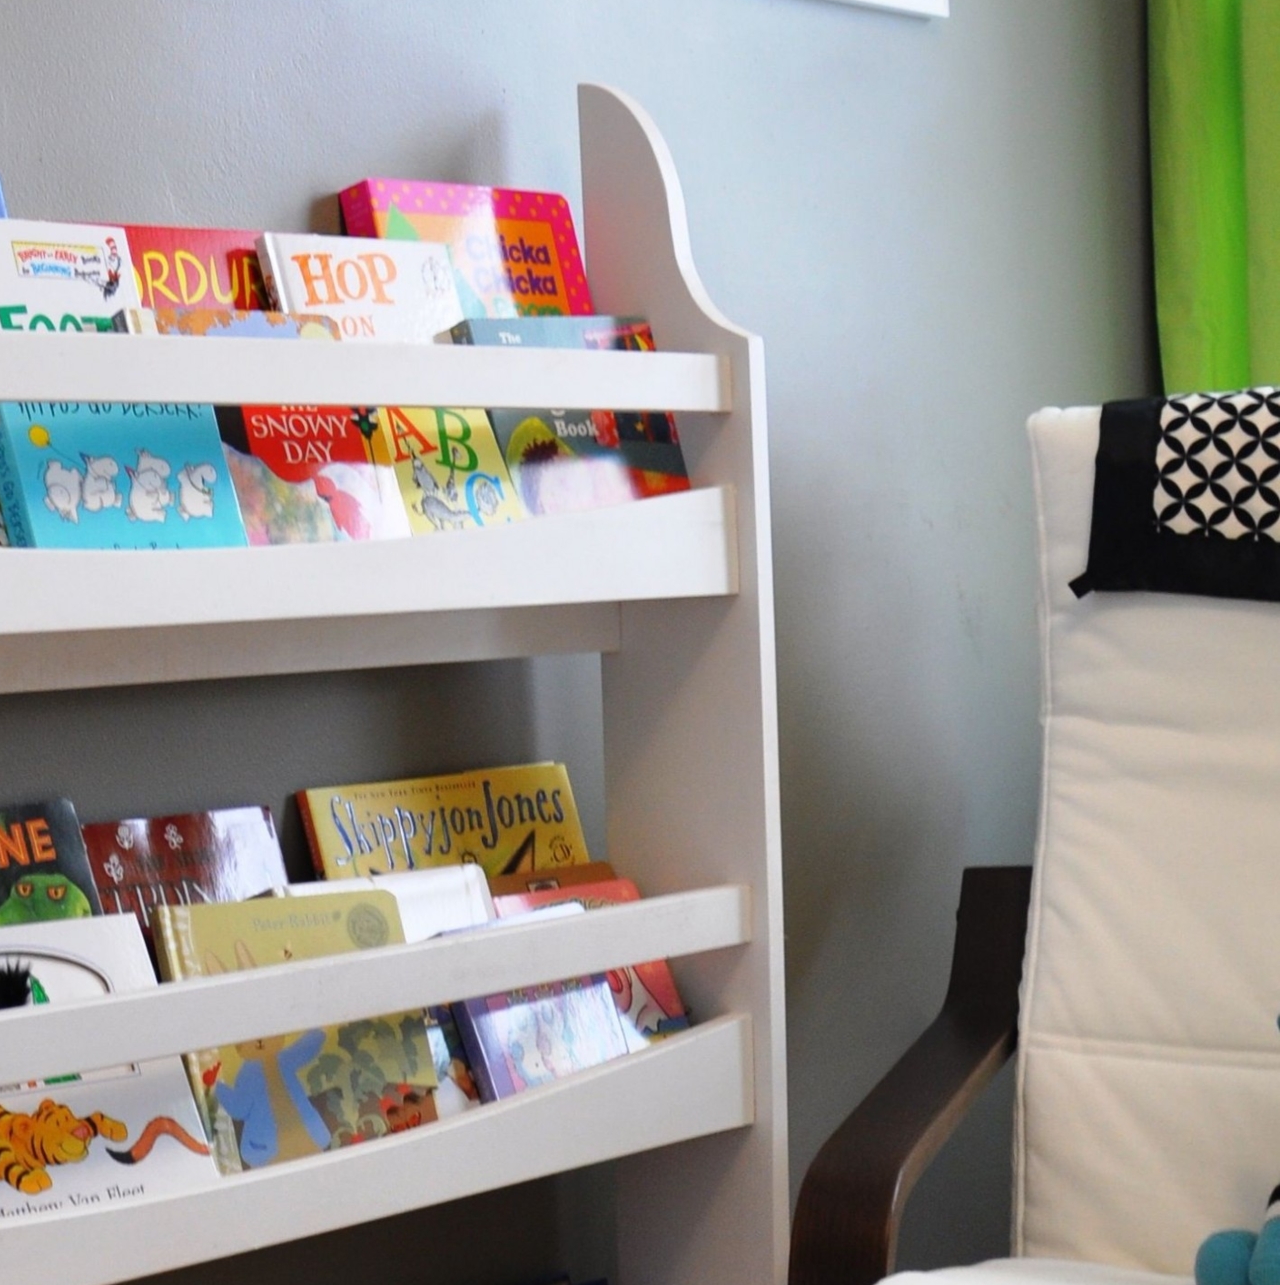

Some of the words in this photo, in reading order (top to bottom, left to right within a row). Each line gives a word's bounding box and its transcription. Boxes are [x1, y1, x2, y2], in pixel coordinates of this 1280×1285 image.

[465, 234, 551, 265] Chicka
[291, 251, 397, 307] HOP
[474, 267, 558, 296] Chicka
[341, 315, 375, 337] ON
[251, 414, 349, 439] SNOWY
[554, 419, 599, 438] Book
[282, 440, 333, 464] DAY
